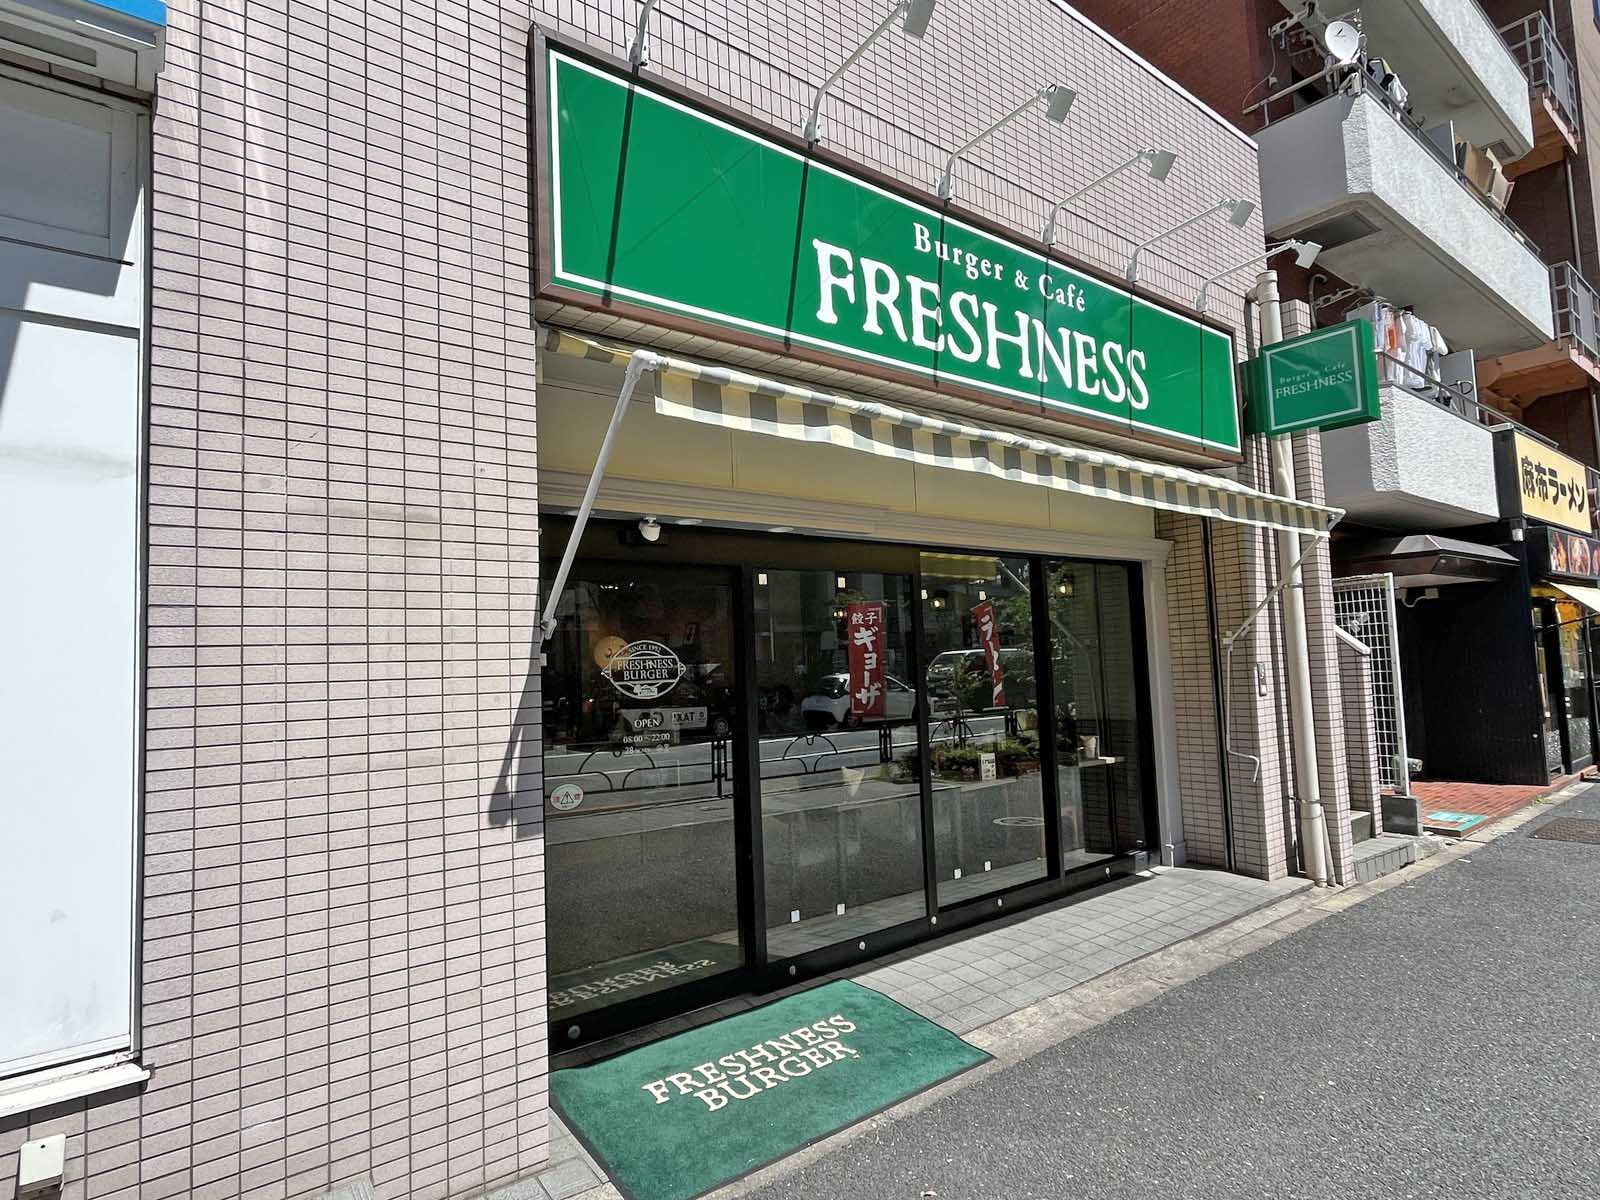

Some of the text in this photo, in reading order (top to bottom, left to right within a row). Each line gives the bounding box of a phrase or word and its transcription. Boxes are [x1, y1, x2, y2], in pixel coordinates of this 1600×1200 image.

[912, 222, 1086, 312] Burger & Café
[812, 238, 1150, 410] FRESHNESS
[1275, 370, 1353, 399] FRESHNESS
[1521, 456, 1585, 513] 麻布ラーメン
[851, 611, 878, 625] 餃子
[617, 659, 674, 671] FRESHNESS
[628, 644, 648, 654] SINCE
[853, 625, 882, 710] ギョーザ
[623, 669, 669, 681] BURGER
[634, 719, 660, 729] OPEN
[641, 1014, 857, 1104] FRESHNESS
[693, 1041, 857, 1111] BURGER
